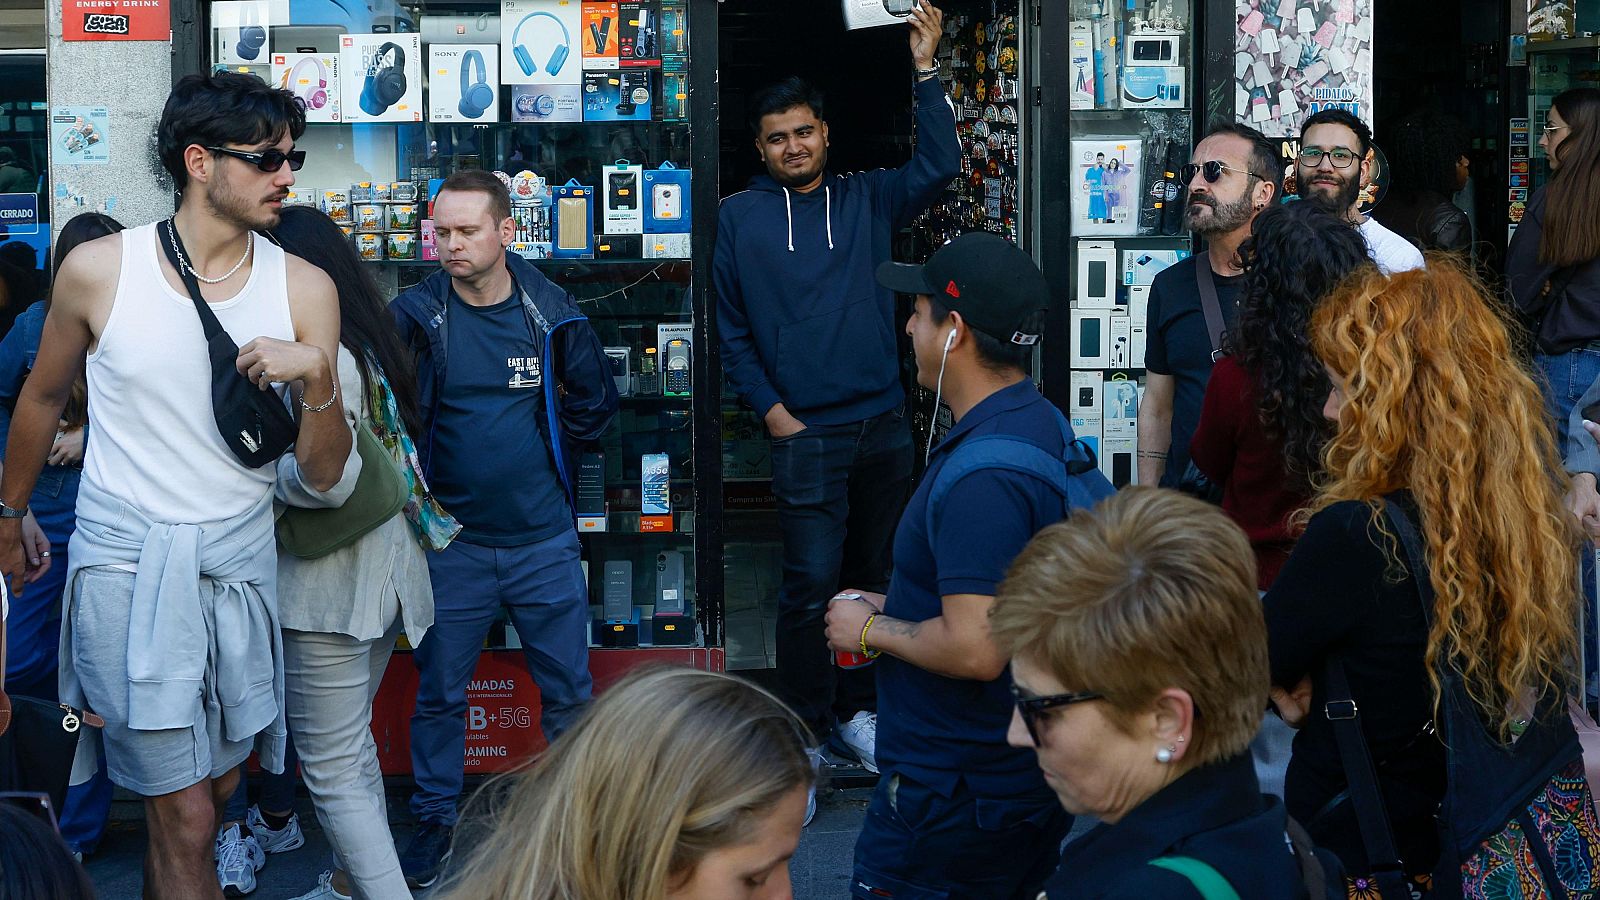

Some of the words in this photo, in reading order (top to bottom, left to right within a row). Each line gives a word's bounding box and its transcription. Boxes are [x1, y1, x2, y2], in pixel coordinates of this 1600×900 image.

[362, 45, 382, 55] PURE
[362, 54, 392, 70] BASS
[1314, 88, 1354, 100] PIDALOS
[1282, 141, 1300, 158] N
[0, 209, 34, 218] CERRADO
[508, 358, 524, 368] EAST
[643, 466, 668, 474] A35e
[464, 746, 507, 756] AMING
